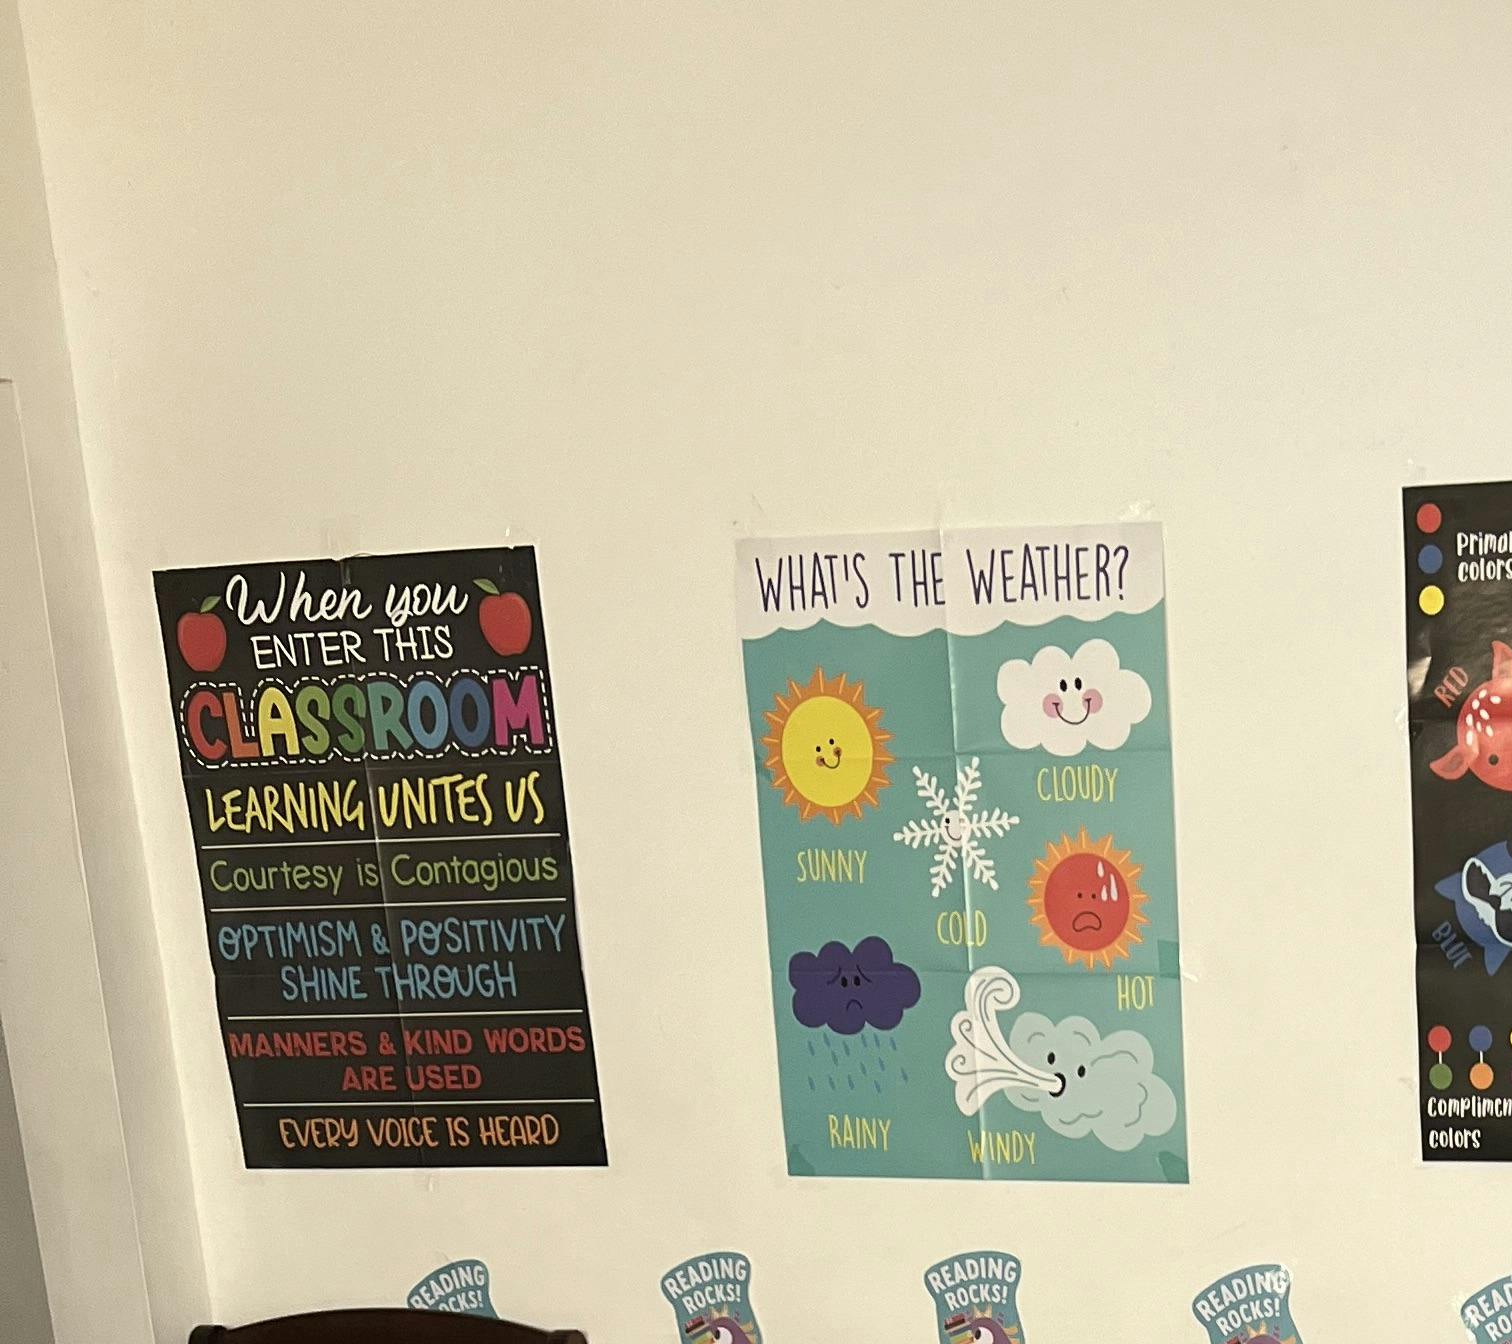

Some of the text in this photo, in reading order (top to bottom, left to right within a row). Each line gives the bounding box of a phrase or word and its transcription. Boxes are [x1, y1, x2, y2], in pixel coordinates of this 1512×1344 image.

[755, 545, 1129, 613] WHAT'S THE WEATHER?
[226, 572, 469, 628] When you
[251, 625, 453, 669] ENTER THIS
[1433, 666, 1468, 708] RED
[187, 676, 545, 761] CLASSROOM
[205, 772, 545, 833] LEARNING UNITES US
[1037, 766, 1117, 803] CLOUDY
[211, 854, 558, 895] Courtesy is Contagious
[797, 850, 867, 883] SUNNY
[218, 914, 567, 960] OPTIMISM & POSITIVITY
[937, 911, 987, 946] COLD
[1432, 921, 1472, 969] BLUE
[281, 963, 516, 1001] SHINE THROUGH
[1117, 976, 1153, 1011] HOT
[230, 1026, 584, 1058] MANNERS & KIND WORDS
[342, 1065, 481, 1092] ARE USED
[280, 1114, 559, 1149] EVERY VOICE IS HEARD
[828, 1115, 891, 1151] RAINY
[968, 1130, 1037, 1164] WINDY
[1429, 1127, 1480, 1149] colors
[410, 1265, 485, 1309] READING
[665, 1258, 747, 1299] READING
[927, 1257, 1018, 1293] READING
[682, 1284, 741, 1313] ROCKS!
[944, 1286, 1007, 1310] ROCKS!
[1196, 1270, 1289, 1322] READING
[1216, 1298, 1280, 1336] ROCKS!
